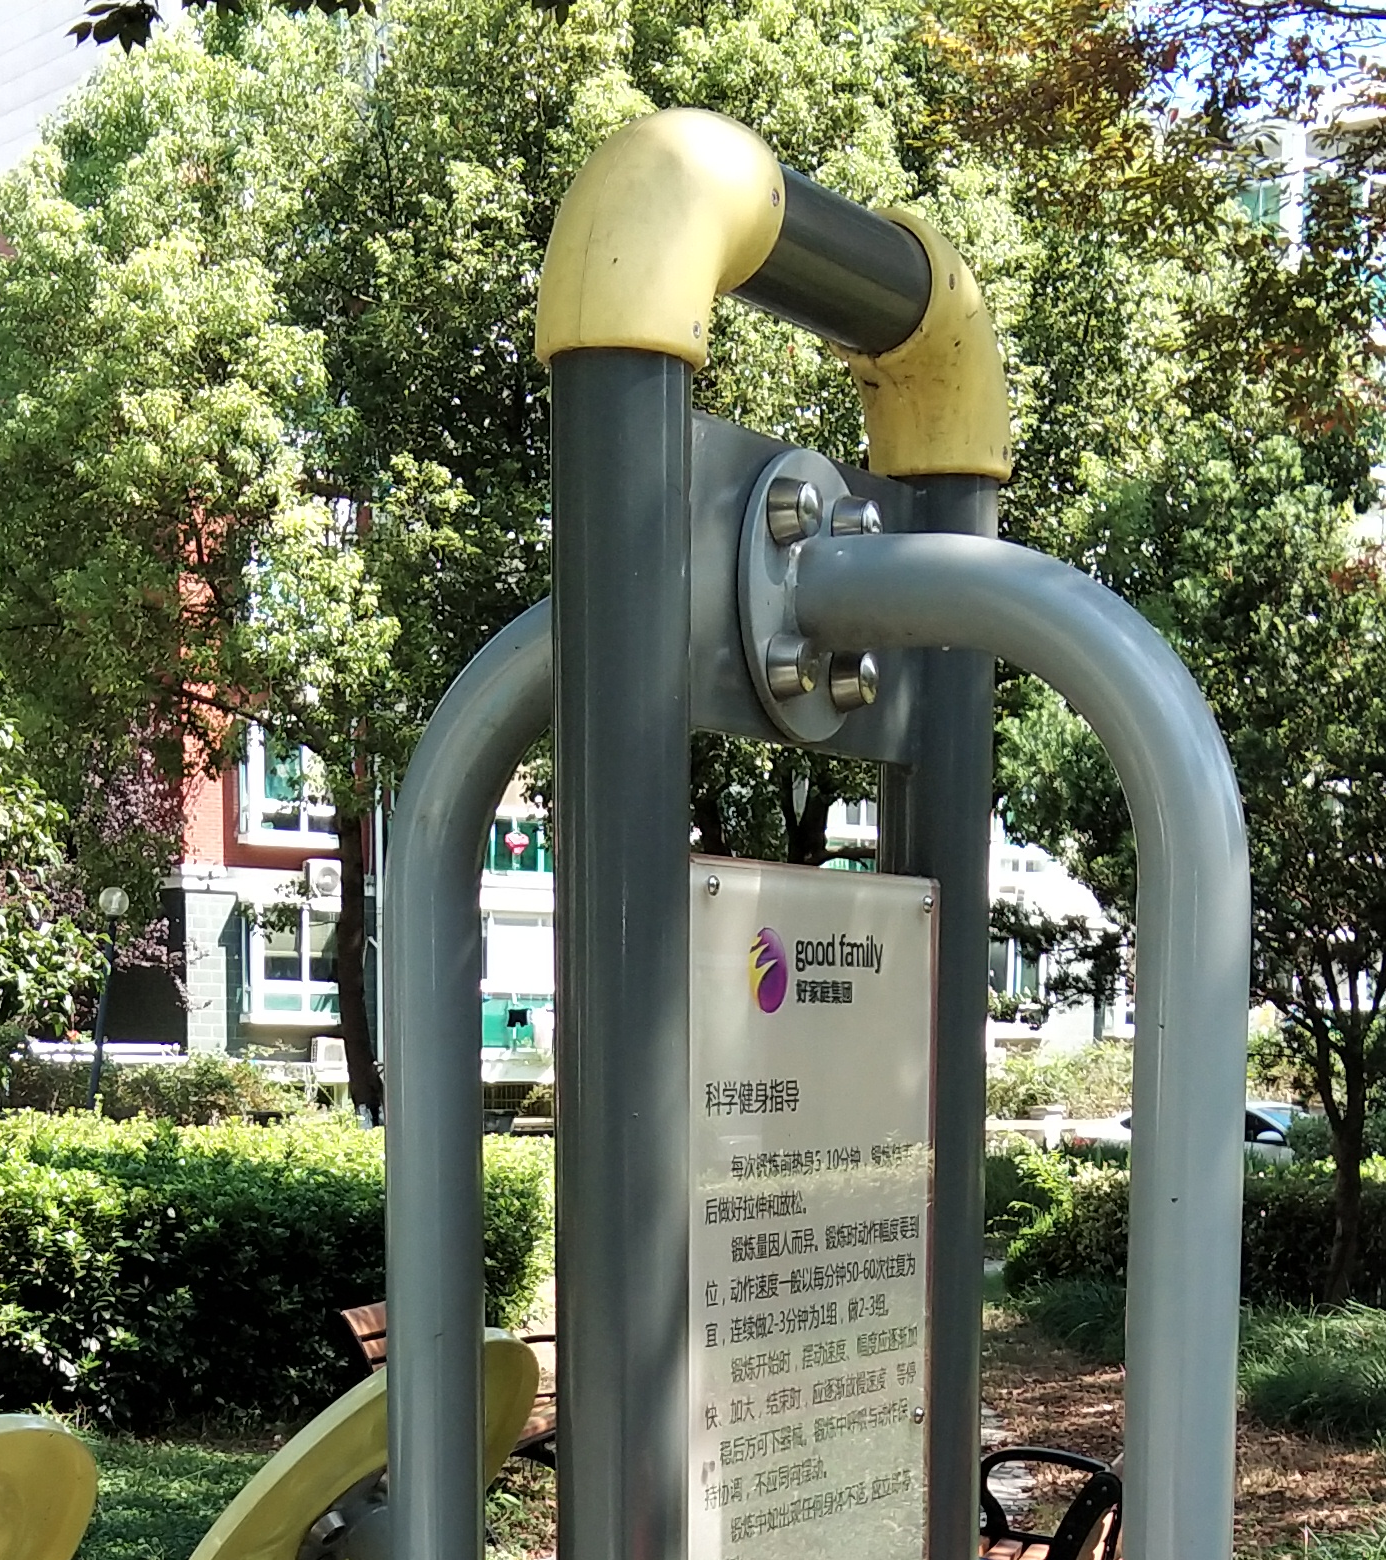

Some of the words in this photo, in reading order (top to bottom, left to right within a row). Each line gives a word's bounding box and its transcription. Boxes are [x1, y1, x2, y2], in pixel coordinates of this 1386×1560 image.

[795, 934, 835, 973] good
[839, 933, 884, 975] family
[796, 980, 853, 1004] 好家庭集团
[705, 1079, 800, 1117] 科学健身指导
[705, 1189, 806, 1225] 后做好拉伸和放松。
[731, 1214, 919, 1264] 锻炼量因人而异。锻炼时动作幅度要到
[705, 1250, 915, 1309] 位，动作速度一般以每分钟50-60次往复为
[705, 1292, 888, 1349] 宜，连续做2-3分钟为1组，做2-3组。
